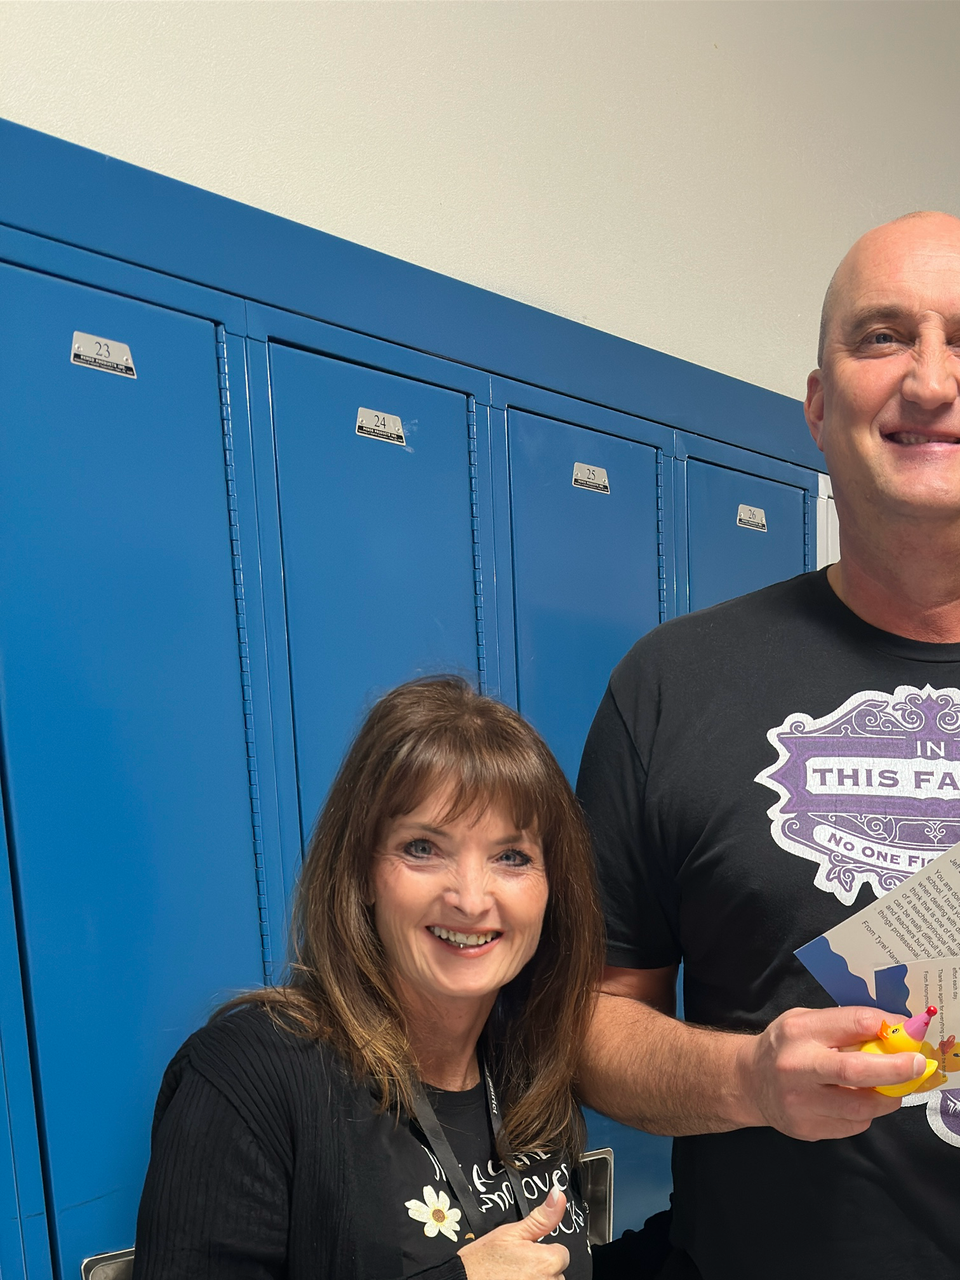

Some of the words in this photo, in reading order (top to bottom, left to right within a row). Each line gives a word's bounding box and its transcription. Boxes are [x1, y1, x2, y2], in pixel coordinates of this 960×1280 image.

[95, 341, 110, 358] 23
[374, 414, 386, 429] 24
[586, 468, 596, 481] 25
[748, 508, 757, 521] 26
[916, 741, 945, 757] IN
[812, 767, 899, 788] THIS
[827, 832, 855, 852] NO
[861, 846, 901, 866] ONE
[934, 869, 945, 883] You
[943, 881, 953, 892] are
[909, 886, 923, 902] think
[925, 875, 944, 896] school.
[944, 897, 957, 912] trust
[917, 881, 932, 898] when
[930, 897, 948, 918] dealing
[946, 915, 957, 928] with
[920, 900, 932, 913] that
[929, 910, 936, 919] is
[934, 917, 945, 929] one
[885, 904, 898, 917] and
[895, 915, 916, 939] teachers
[914, 937, 925, 948] but
[920, 947, 932, 958] you
[893, 899, 904, 911] can
[902, 909, 911, 919] be
[909, 917, 923, 933] really
[921, 932, 939, 951] difficult
[936, 949, 943, 957] to
[910, 903, 949, 946] teacher/principal
[943, 927, 952, 935] of
[861, 920, 876, 937] From
[875, 935, 889, 951] Tyrel
[877, 909, 894, 928] things
[890, 927, 921, 960] professional.
[947, 933, 957, 943] the
